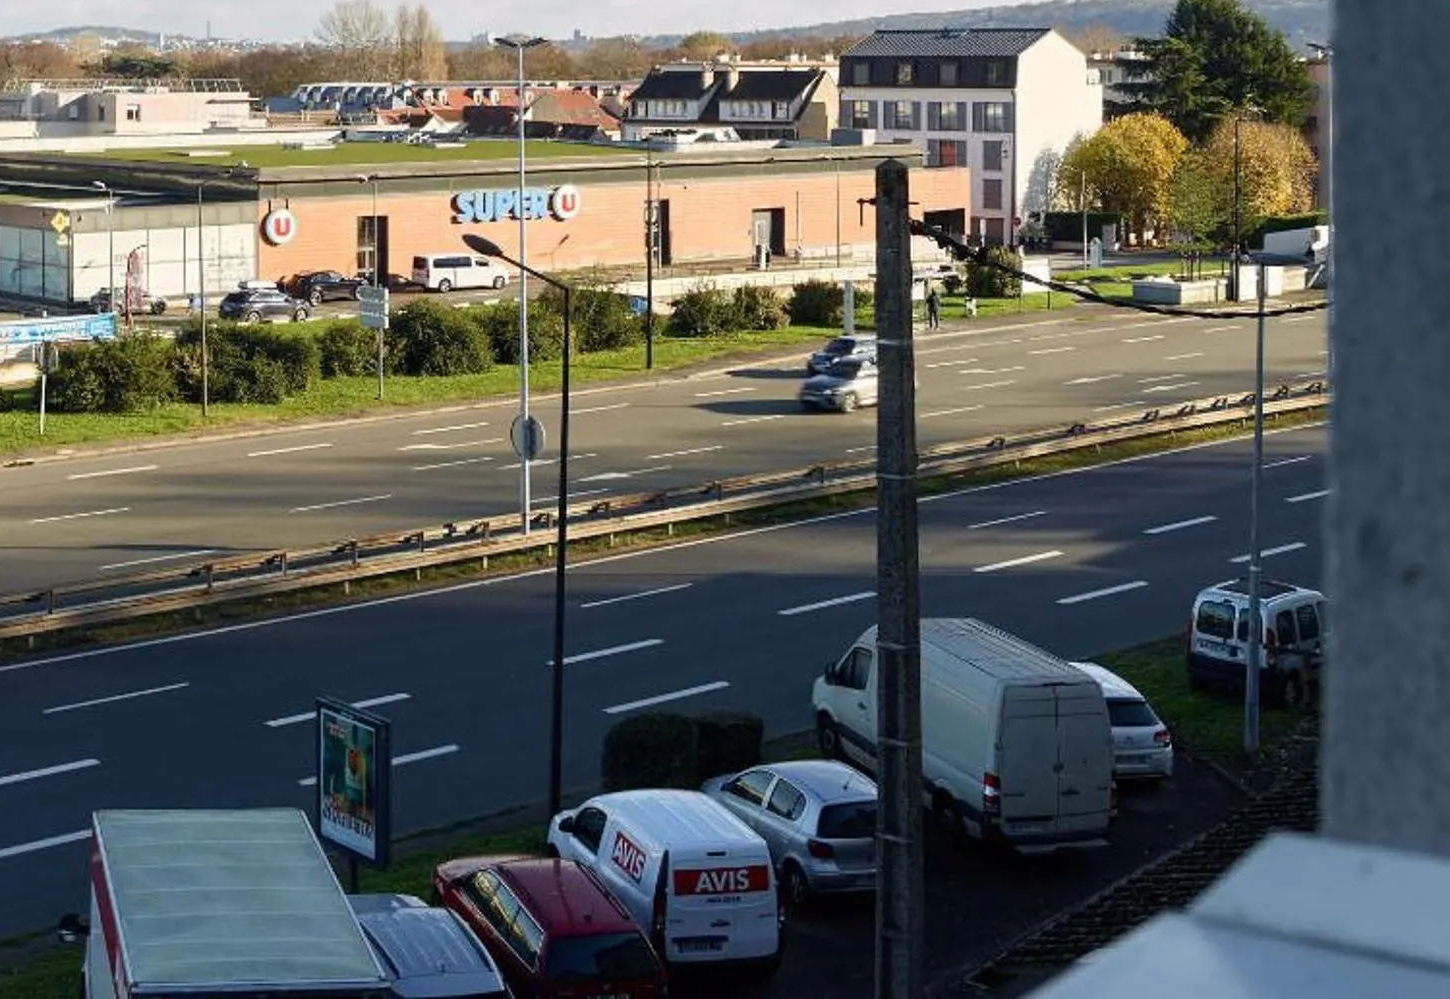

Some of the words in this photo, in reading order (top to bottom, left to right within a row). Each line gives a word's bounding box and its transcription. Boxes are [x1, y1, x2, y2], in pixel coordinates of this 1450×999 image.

[456, 188, 548, 223] SUPER
[561, 194, 576, 212] U
[274, 217, 290, 236] U
[613, 836, 646, 879] AVIS
[695, 869, 751, 893] AVIS
